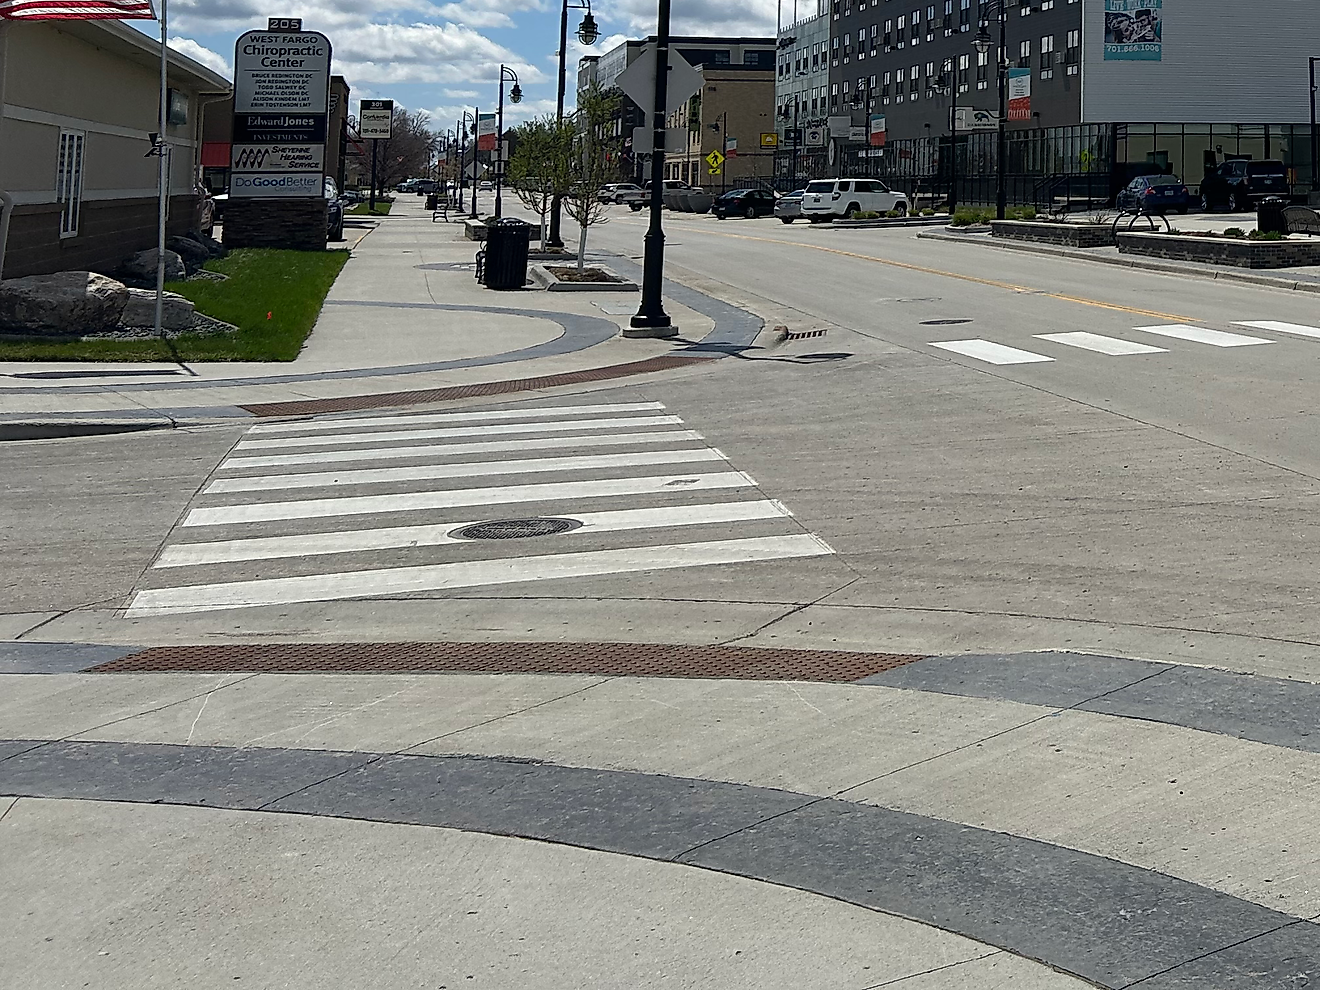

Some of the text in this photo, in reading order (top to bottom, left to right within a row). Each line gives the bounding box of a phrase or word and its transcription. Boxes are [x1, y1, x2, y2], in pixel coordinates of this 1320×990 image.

[270, 19, 299, 29] 205
[249, 35, 318, 44] WEST FARGO
[243, 44, 323, 58] Chiropractic
[260, 57, 305, 68] Center
